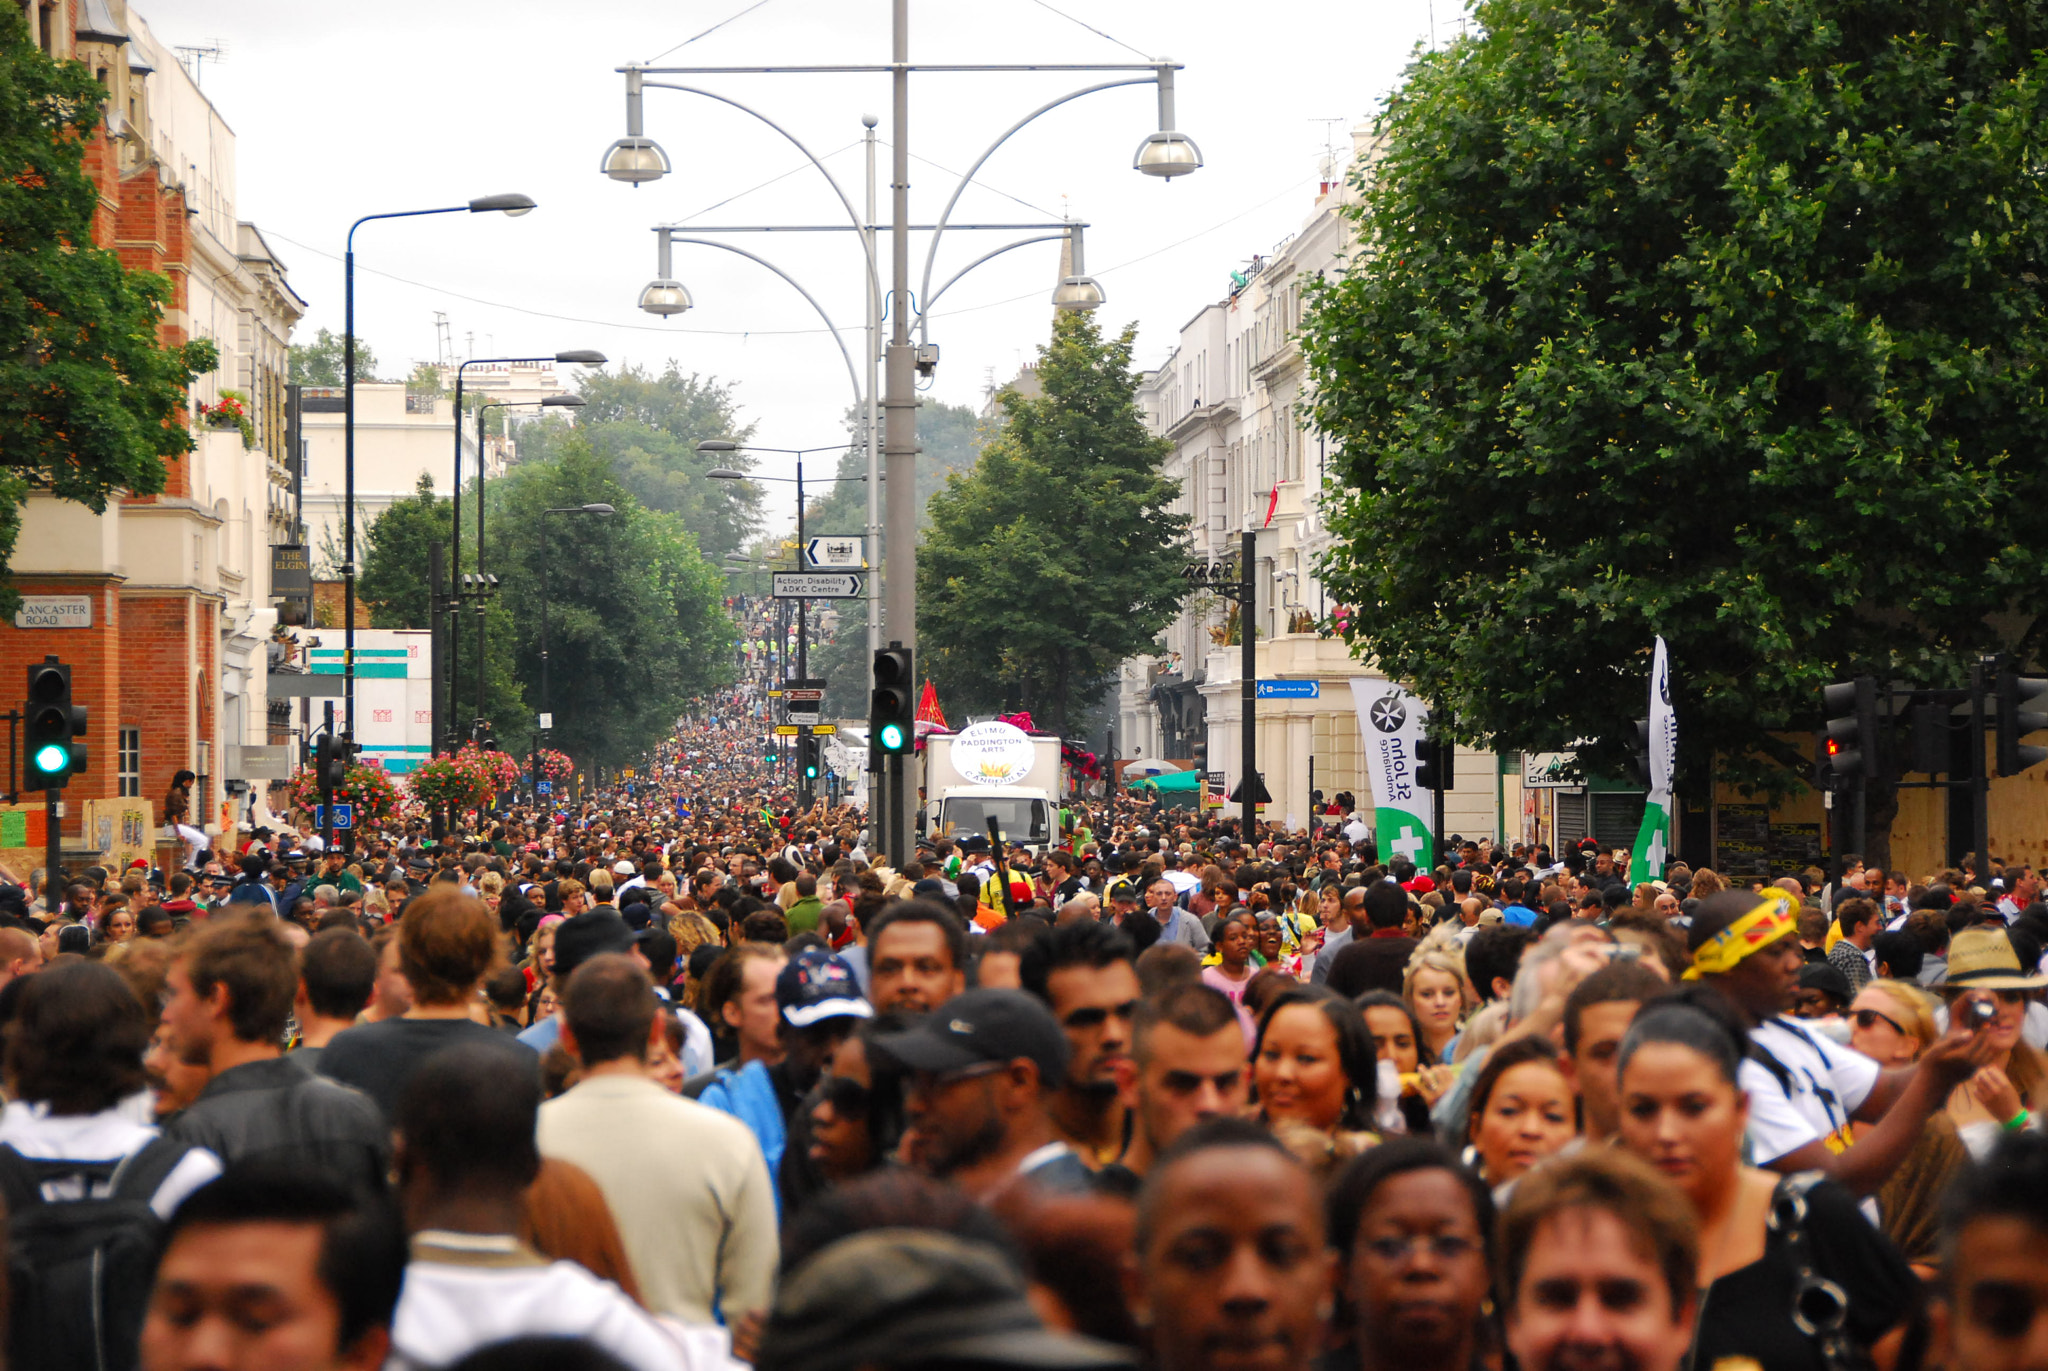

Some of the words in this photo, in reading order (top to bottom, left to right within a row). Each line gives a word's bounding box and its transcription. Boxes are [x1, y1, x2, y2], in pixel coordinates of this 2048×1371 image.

[280, 551, 301, 560] THE
[275, 561, 307, 570] ELGIN
[776, 577, 804, 585] Action
[807, 577, 846, 586] Disability
[25, 615, 58, 625] ROAD
[970, 727, 1006, 737] ELIMU
[960, 739, 1022, 747] PADDINGTON
